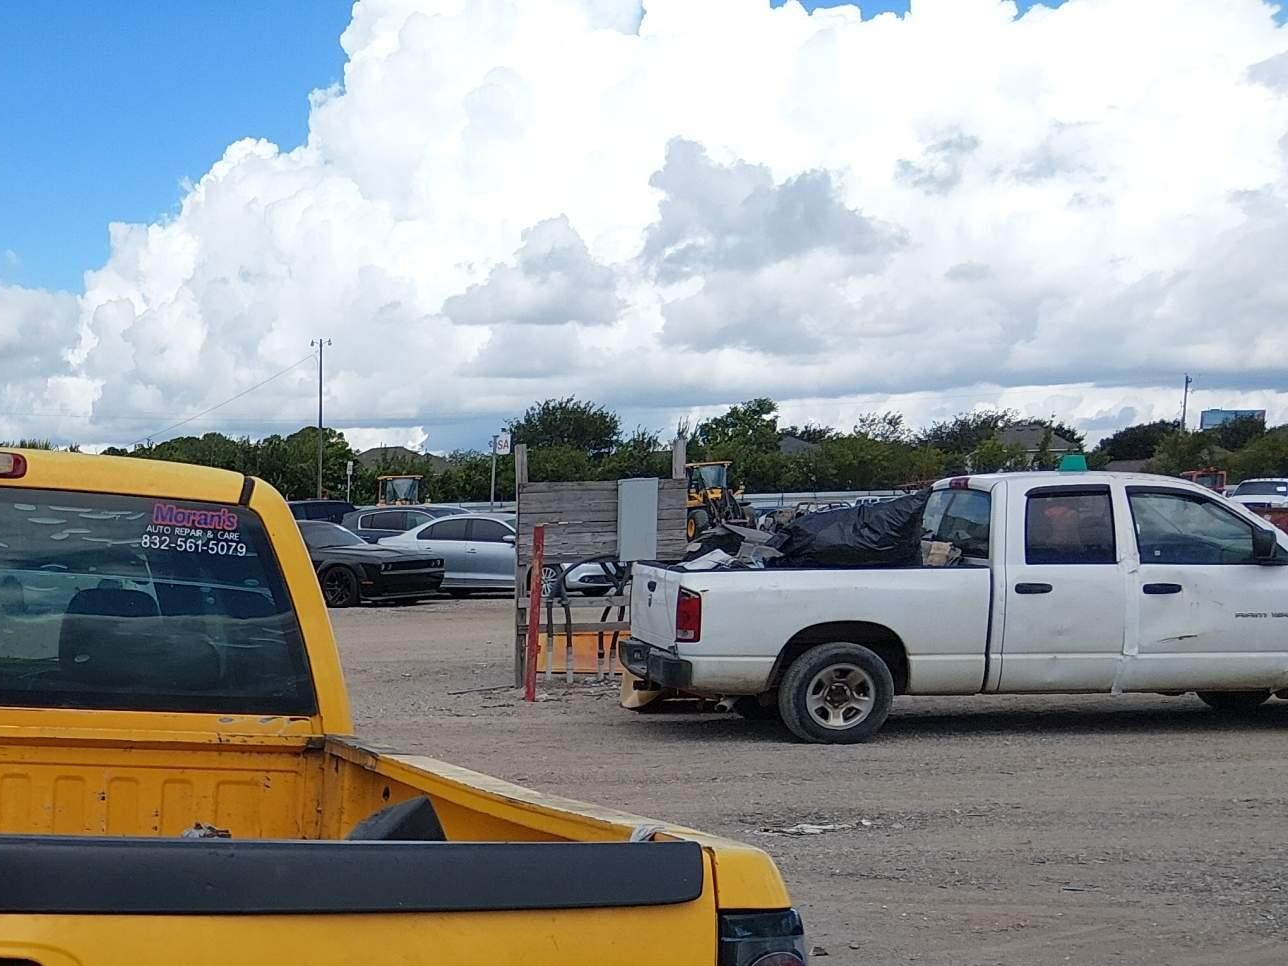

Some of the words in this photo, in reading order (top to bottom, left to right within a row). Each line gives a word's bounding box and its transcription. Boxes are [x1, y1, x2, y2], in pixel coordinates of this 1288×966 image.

[152, 503, 238, 530] Moran's
[146, 525, 171, 534] AUTO
[174, 527, 203, 537] REPAIR
[206, 530, 214, 538] &
[217, 531, 240, 541] CARE
[141, 534, 247, 557] 832-561-5079
